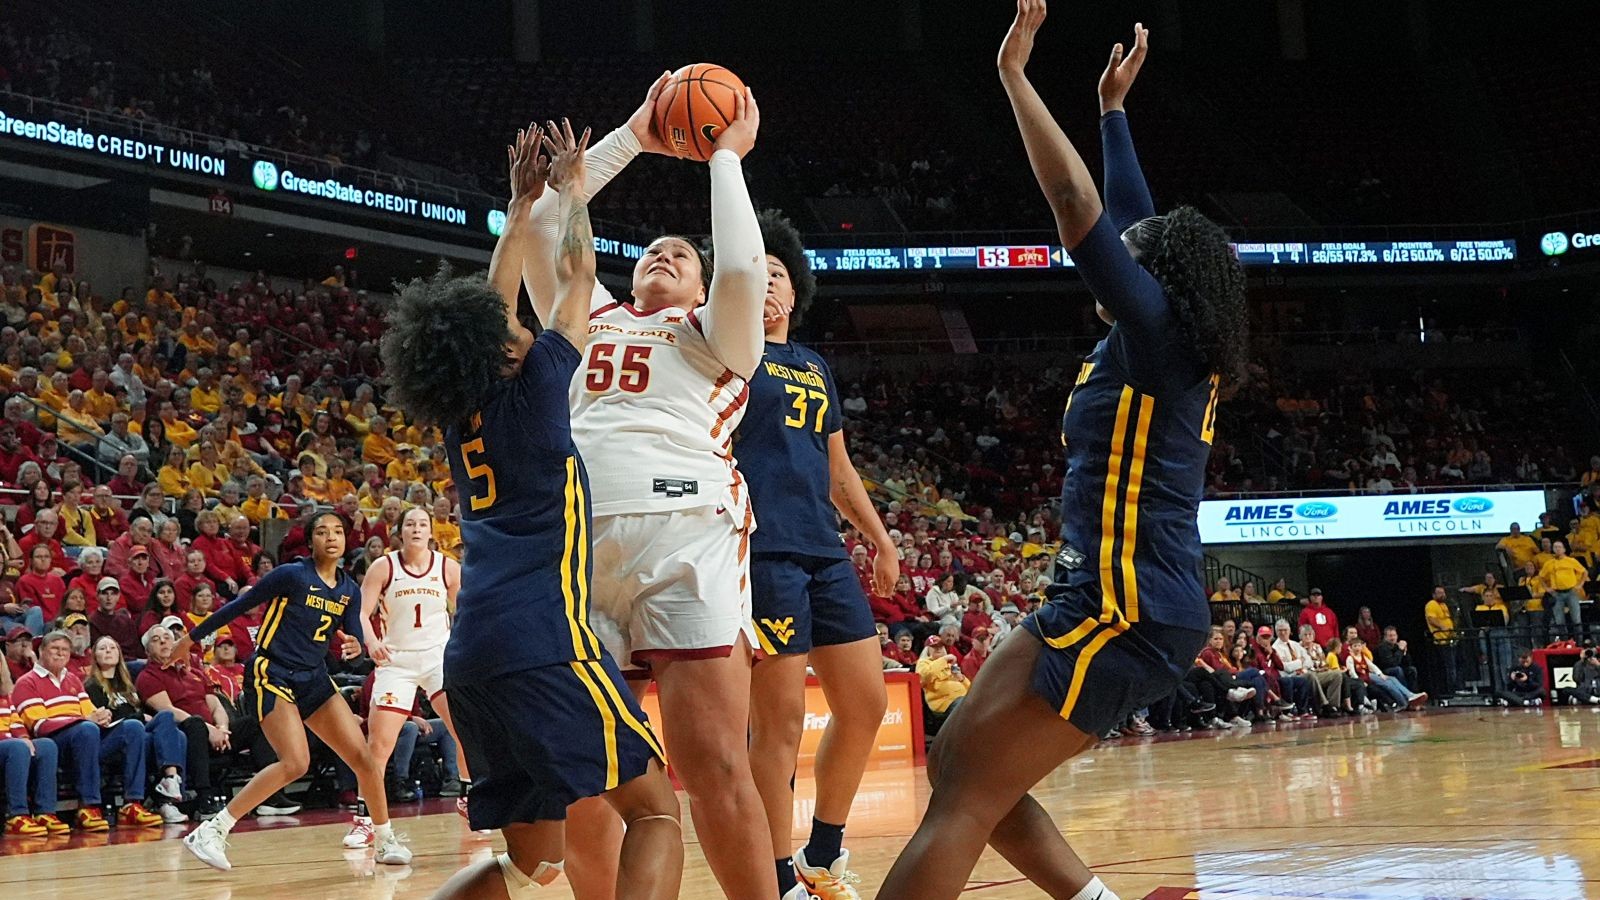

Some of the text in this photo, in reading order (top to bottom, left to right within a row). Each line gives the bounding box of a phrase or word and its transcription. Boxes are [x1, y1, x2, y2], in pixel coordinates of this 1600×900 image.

[169, 149, 225, 176] UNION
[281, 170, 466, 225] GreenState CREDIT UNION
[212, 199, 231, 214] 134
[593, 237, 647, 259] EDIT UNI
[1342, 242, 1366, 250] GOALS
[1398, 241, 1433, 249] POINTERS
[1474, 240, 1504, 248] THROWS
[843, 248, 891, 257] FIELD GOALS
[983, 247, 1010, 267] 53
[1017, 253, 1044, 263] STATE
[1272, 251, 1280, 263] 1
[1290, 251, 1300, 263] 4
[1312, 250, 1378, 264] 26/55 47.3%
[1383, 248, 1445, 263] 6/12 50.0%
[1450, 247, 1513, 262] 6/12 50.0%
[836, 256, 900, 270] 16/37 43.2%
[913, 256, 923, 268] 3
[934, 255, 942, 268] 1
[588, 324, 676, 343] OWA STATE
[585, 343, 653, 393] 55
[764, 361, 792, 380] WEST
[784, 383, 829, 433] 37
[460, 436, 497, 512] 5
[1224, 503, 1329, 521] AMES Ford
[1383, 498, 1485, 515] AMES Ford
[1240, 525, 1325, 538] LINCOLN
[1398, 520, 1482, 532] LINCOLN
[395, 587, 440, 598] IOWA STATE
[305, 594, 325, 610] WEST
[414, 603, 422, 628] 1
[313, 614, 332, 642] 2
